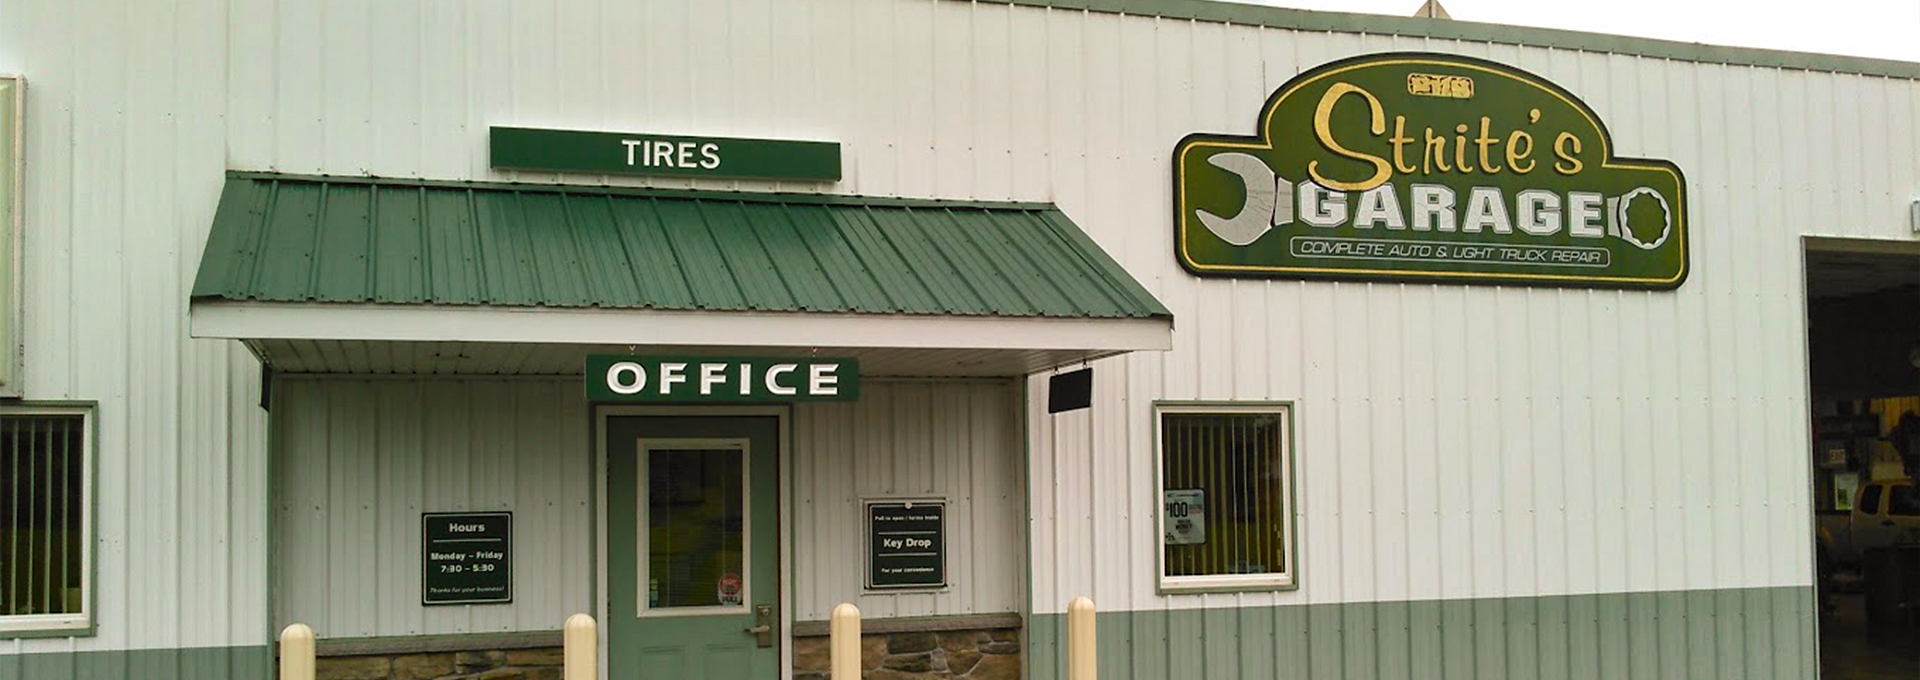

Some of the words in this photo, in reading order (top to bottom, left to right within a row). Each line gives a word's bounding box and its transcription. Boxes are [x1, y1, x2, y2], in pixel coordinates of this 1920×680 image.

[1308, 82, 1583, 191] Strite's
[622, 139, 720, 169] TIRES
[1298, 179, 1605, 238] GARAGE
[1301, 241, 1385, 256] COMPLETE
[1389, 244, 1432, 257] AUTO
[1435, 246, 1448, 258] &
[1453, 247, 1495, 259] LIGHT
[1500, 248, 1548, 261] TRUCK
[1551, 250, 1601, 263] REPAIR
[606, 361, 839, 395] OFFICE
[449, 523, 485, 532] Hours
[883, 539, 903, 549] Key
[906, 538, 931, 549] Drop
[431, 552, 466, 562] Monday
[476, 551, 504, 560] Friday
[440, 565, 462, 573] 7:30
[472, 564, 495, 572] 5:30
